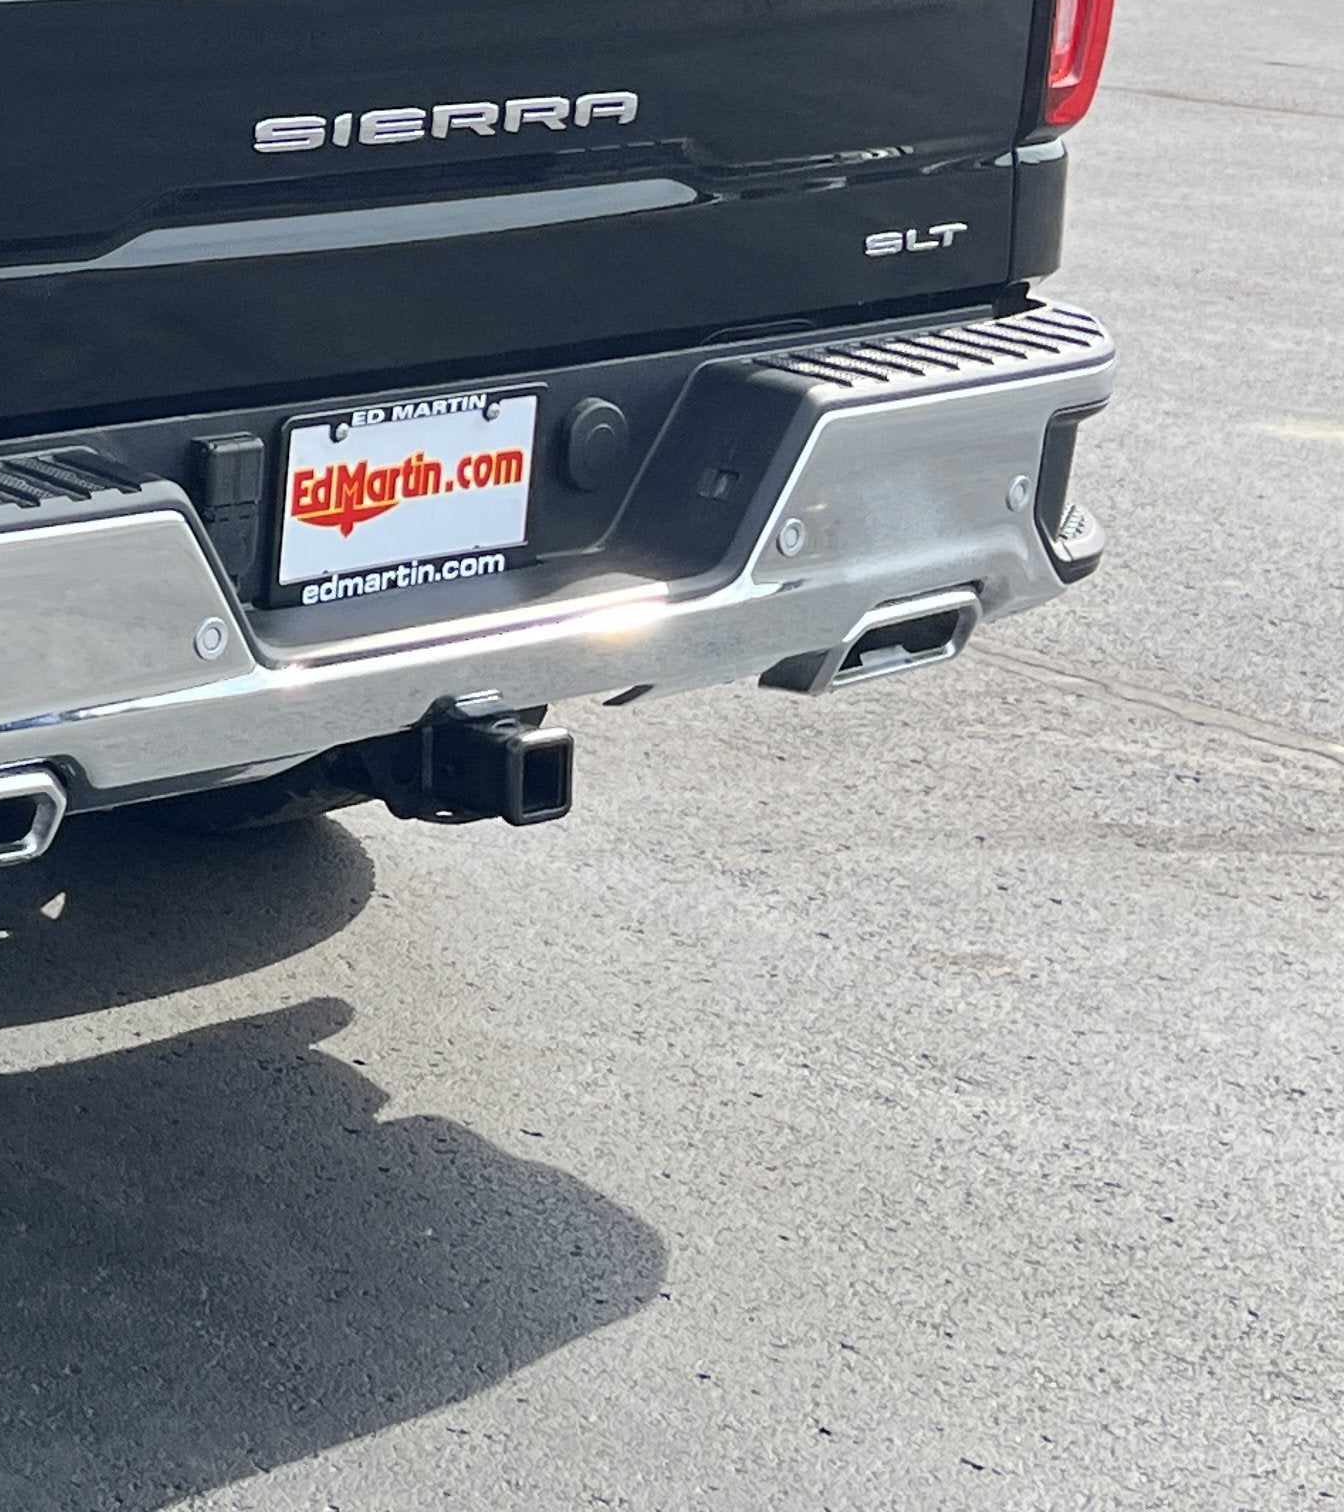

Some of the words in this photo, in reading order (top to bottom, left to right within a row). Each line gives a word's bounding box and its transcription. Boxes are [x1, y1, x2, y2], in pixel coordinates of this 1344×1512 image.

[253, 91, 639, 154] SIERRA
[865, 222, 968, 257] SLT
[352, 411, 385, 426] ED
[391, 394, 486, 421] MARTIN
[302, 553, 505, 606] edmartin.com
